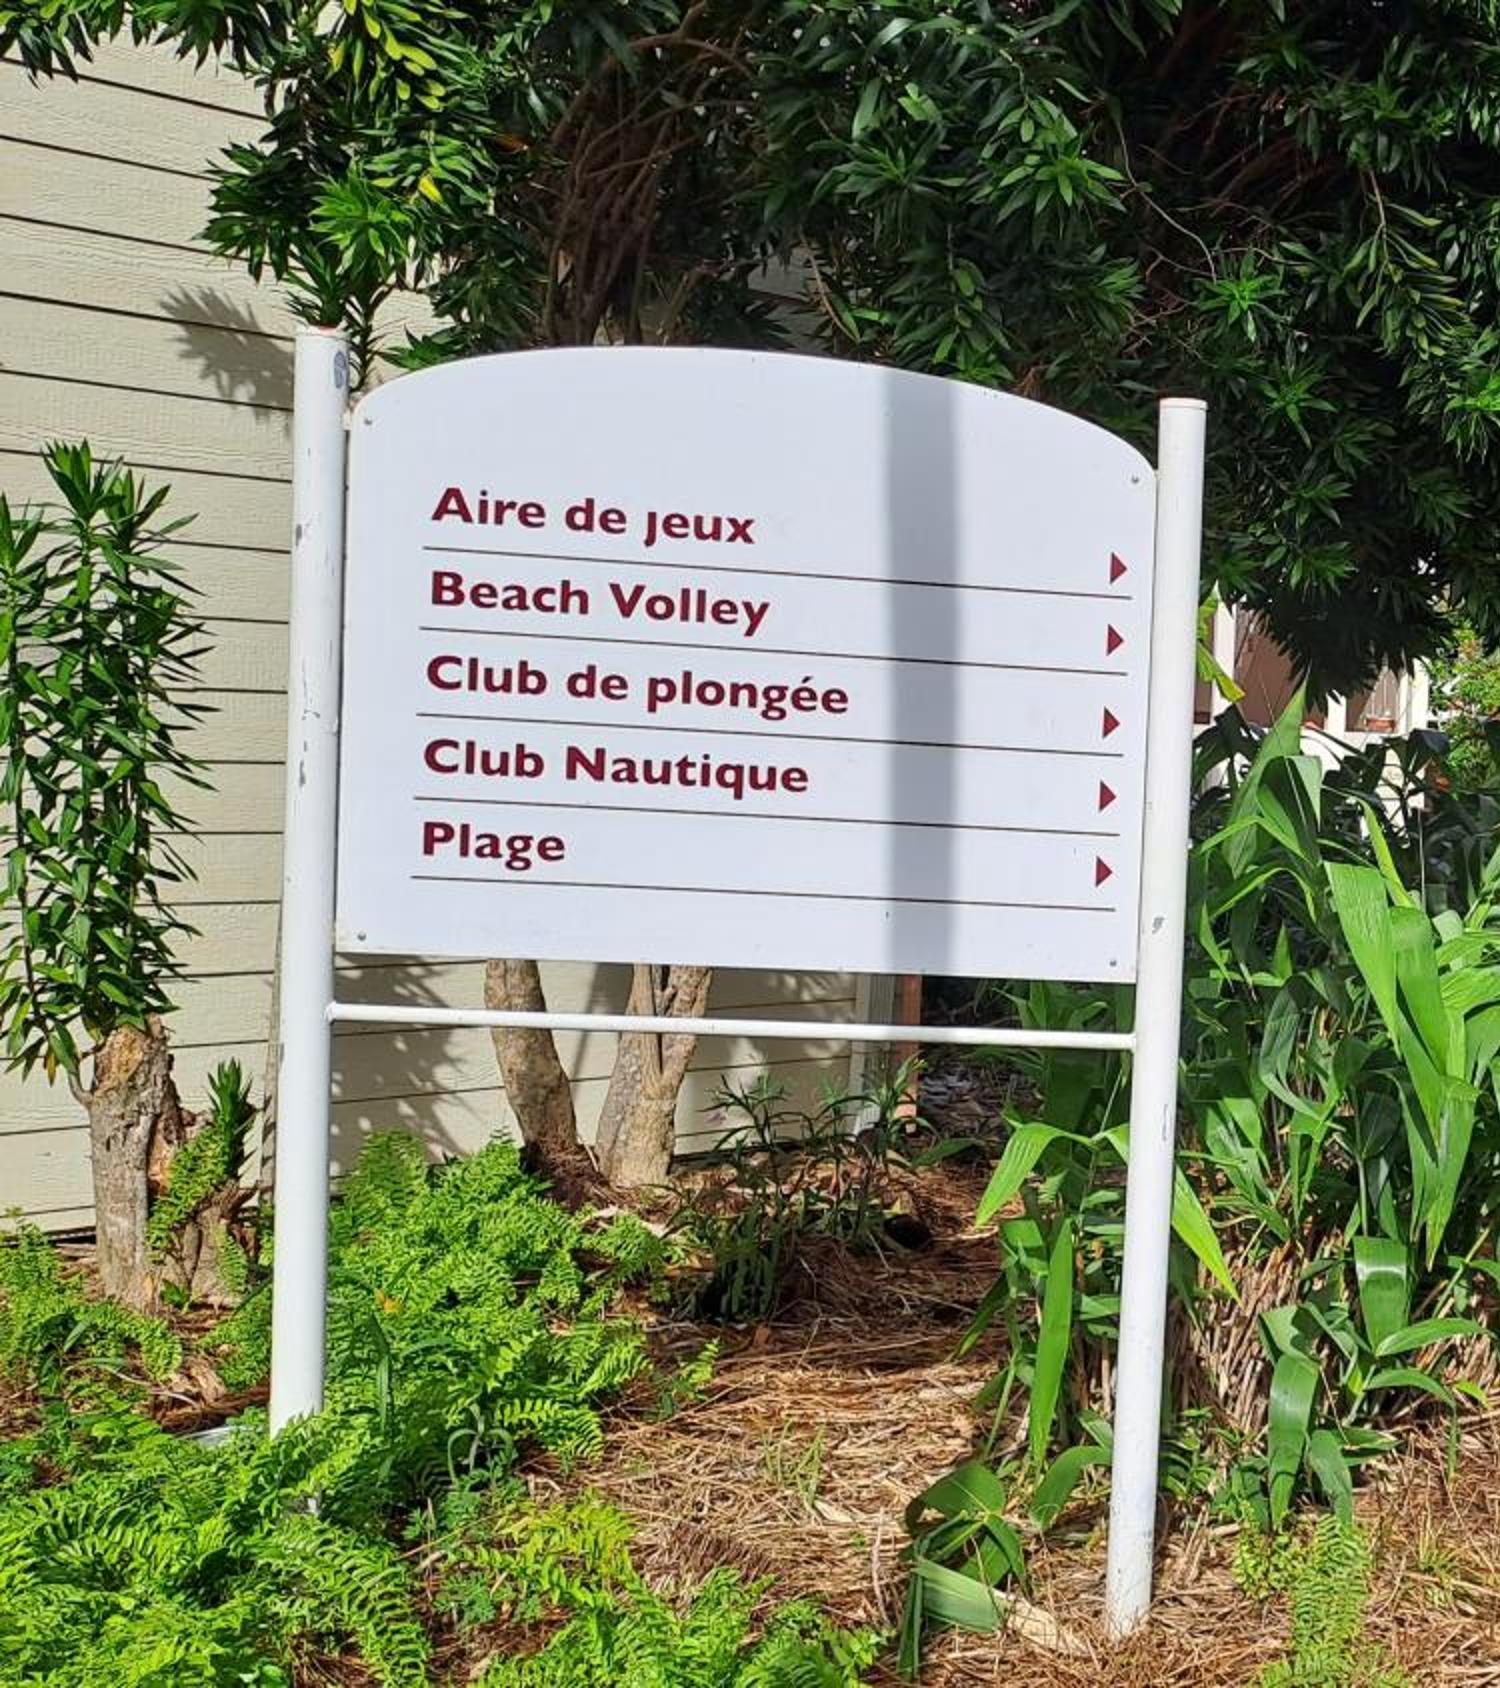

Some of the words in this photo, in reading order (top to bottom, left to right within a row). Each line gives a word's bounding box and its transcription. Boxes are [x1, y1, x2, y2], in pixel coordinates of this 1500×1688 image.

[431, 486, 546, 528] Aire
[564, 497, 626, 535] de
[430, 569, 590, 615] Beach
[609, 582, 770, 637] Volley
[426, 654, 548, 696] Club
[565, 664, 630, 701] de
[646, 669, 849, 722] plongée
[422, 738, 545, 780] Club
[564, 744, 809, 801] Nautique
[421, 820, 566, 870] Plage
